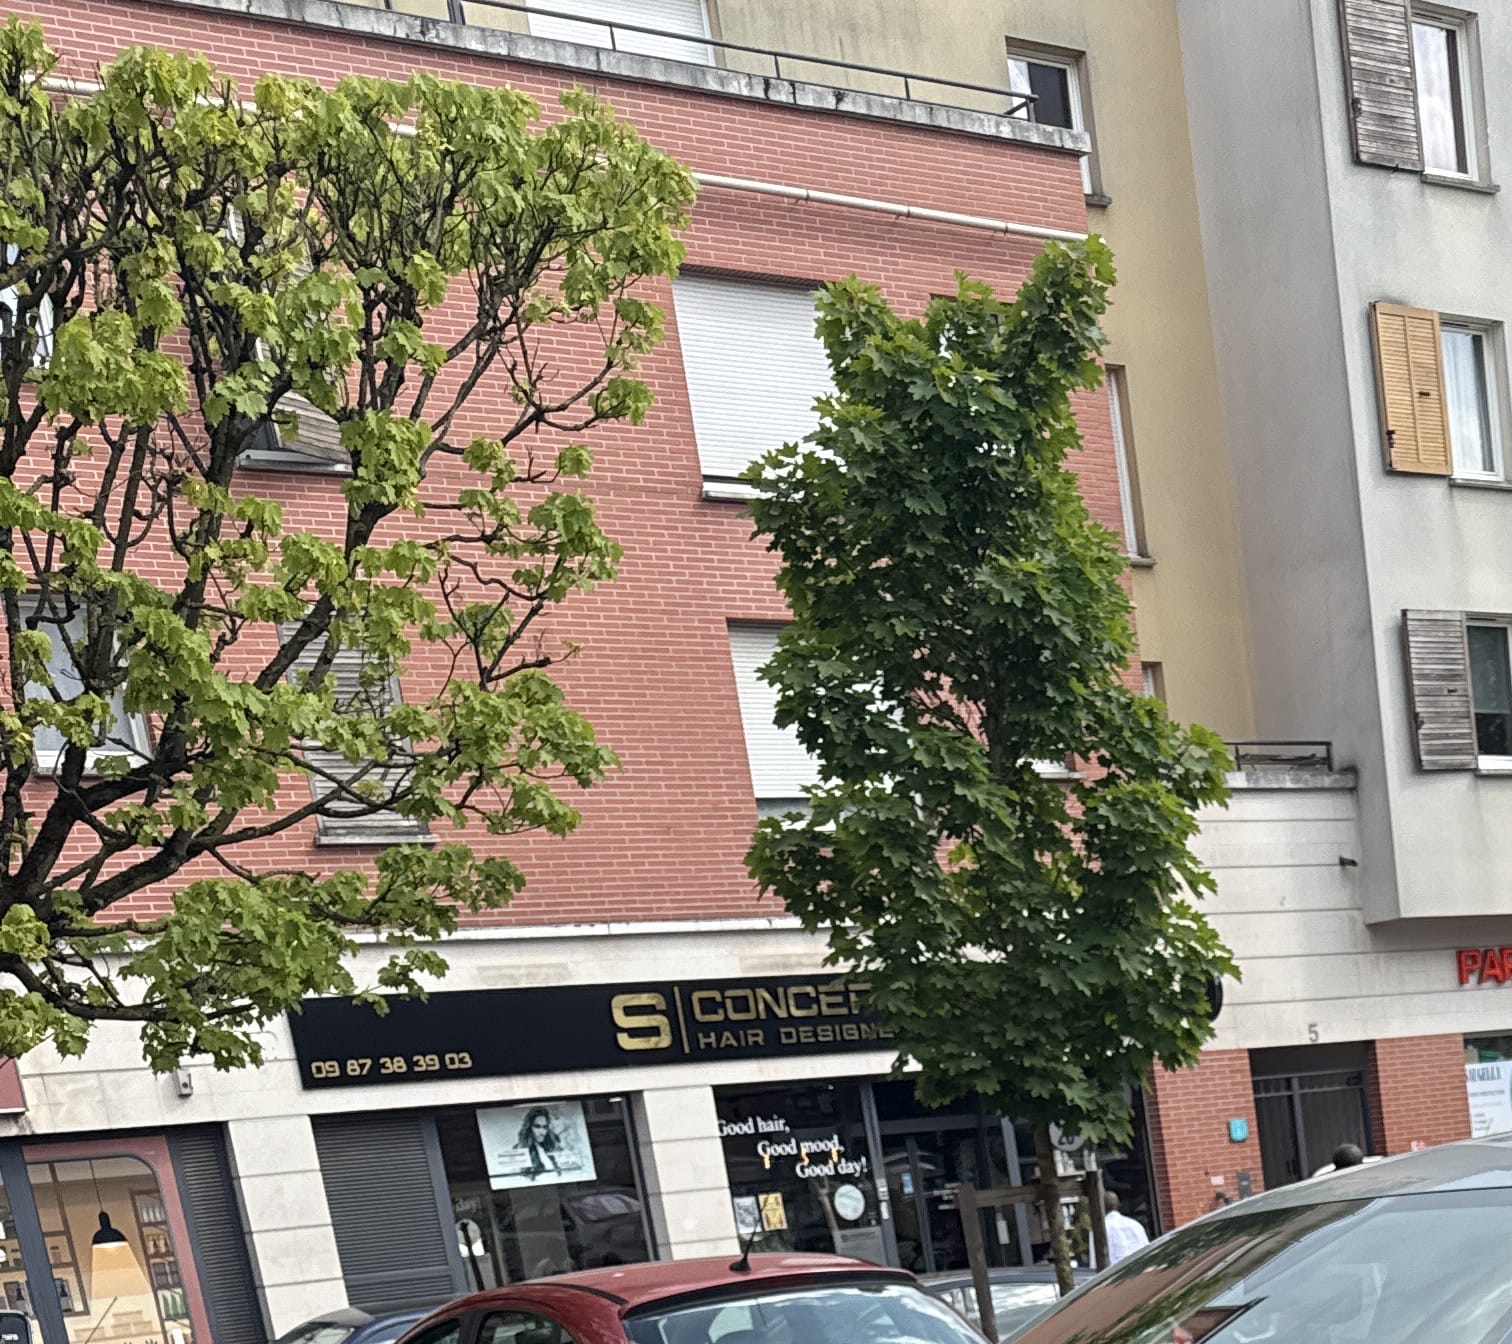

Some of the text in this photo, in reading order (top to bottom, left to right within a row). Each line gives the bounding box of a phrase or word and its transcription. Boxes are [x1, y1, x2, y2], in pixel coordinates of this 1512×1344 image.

[611, 983, 873, 1051] S CONCEP
[697, 1022, 894, 1049] HAIR DESIGNE
[1308, 1023, 1319, 1042] 5
[311, 1052, 473, 1078] 09 87 38 39 03
[718, 1114, 791, 1136] Good hair,
[757, 1133, 845, 1157] Good mood,
[795, 1156, 868, 1178] Good day!
